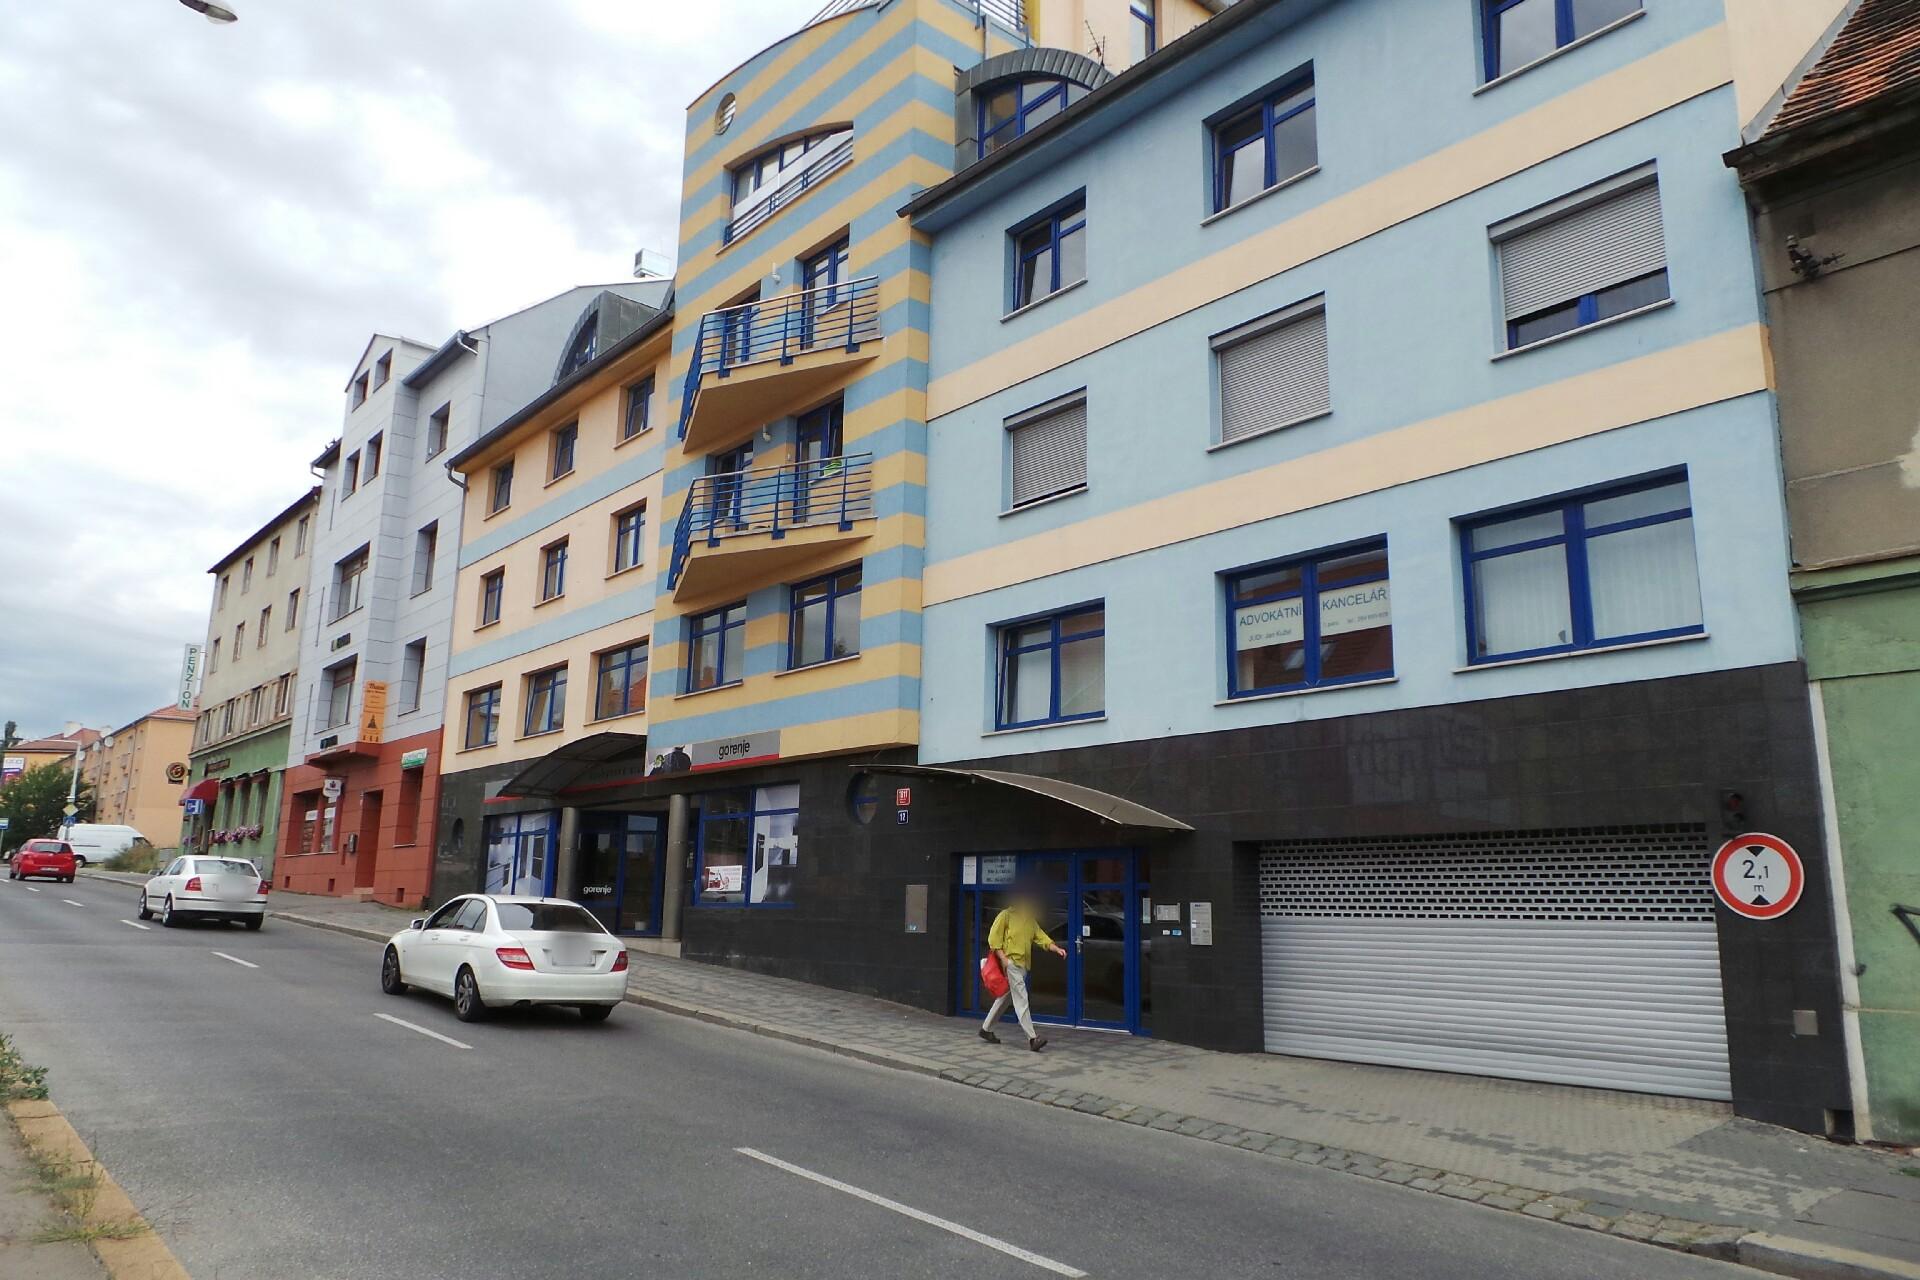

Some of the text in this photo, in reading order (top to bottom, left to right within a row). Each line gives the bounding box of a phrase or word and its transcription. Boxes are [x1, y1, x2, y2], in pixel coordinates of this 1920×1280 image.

[1239, 602, 1302, 626] ADVOKÁTNÍ
[182, 648, 197, 708] PENZION
[719, 740, 750, 760] gorenje
[1742, 859, 1769, 880] 2,1
[583, 885, 612, 895] gorenje
[1753, 884, 1765, 892] m
